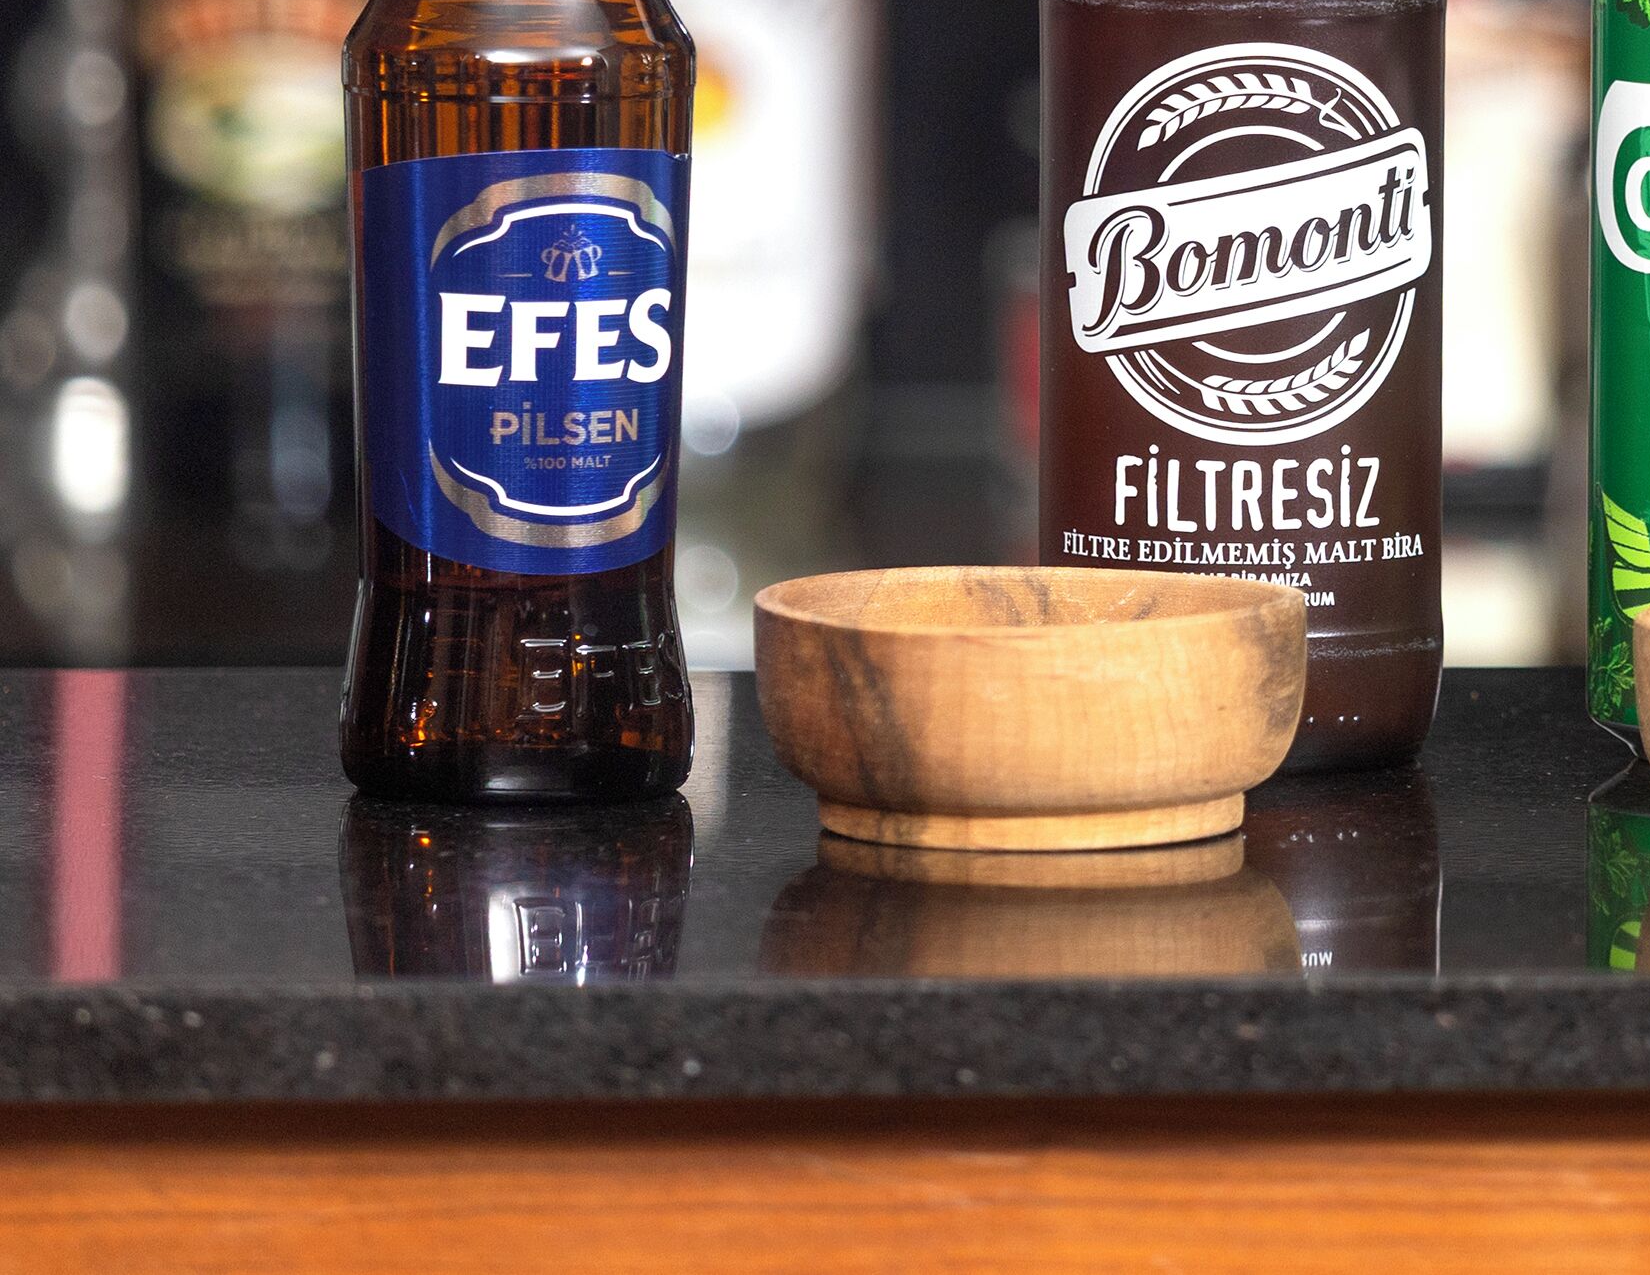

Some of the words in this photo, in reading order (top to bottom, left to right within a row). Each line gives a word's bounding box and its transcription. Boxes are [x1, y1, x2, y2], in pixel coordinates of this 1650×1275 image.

[1082, 166, 1416, 338] Bomonti
[438, 288, 672, 387] EFES
[490, 401, 639, 446] PİLSEN
[523, 456, 567, 470] %100
[571, 455, 612, 469] MALT
[1115, 444, 1380, 533] FİLTRESİZ
[1063, 528, 1131, 561] FİLTRE
[1137, 537, 1296, 570] EDİLMEMİŞ
[1302, 539, 1377, 565] MALT
[1382, 532, 1424, 560] BİRA
